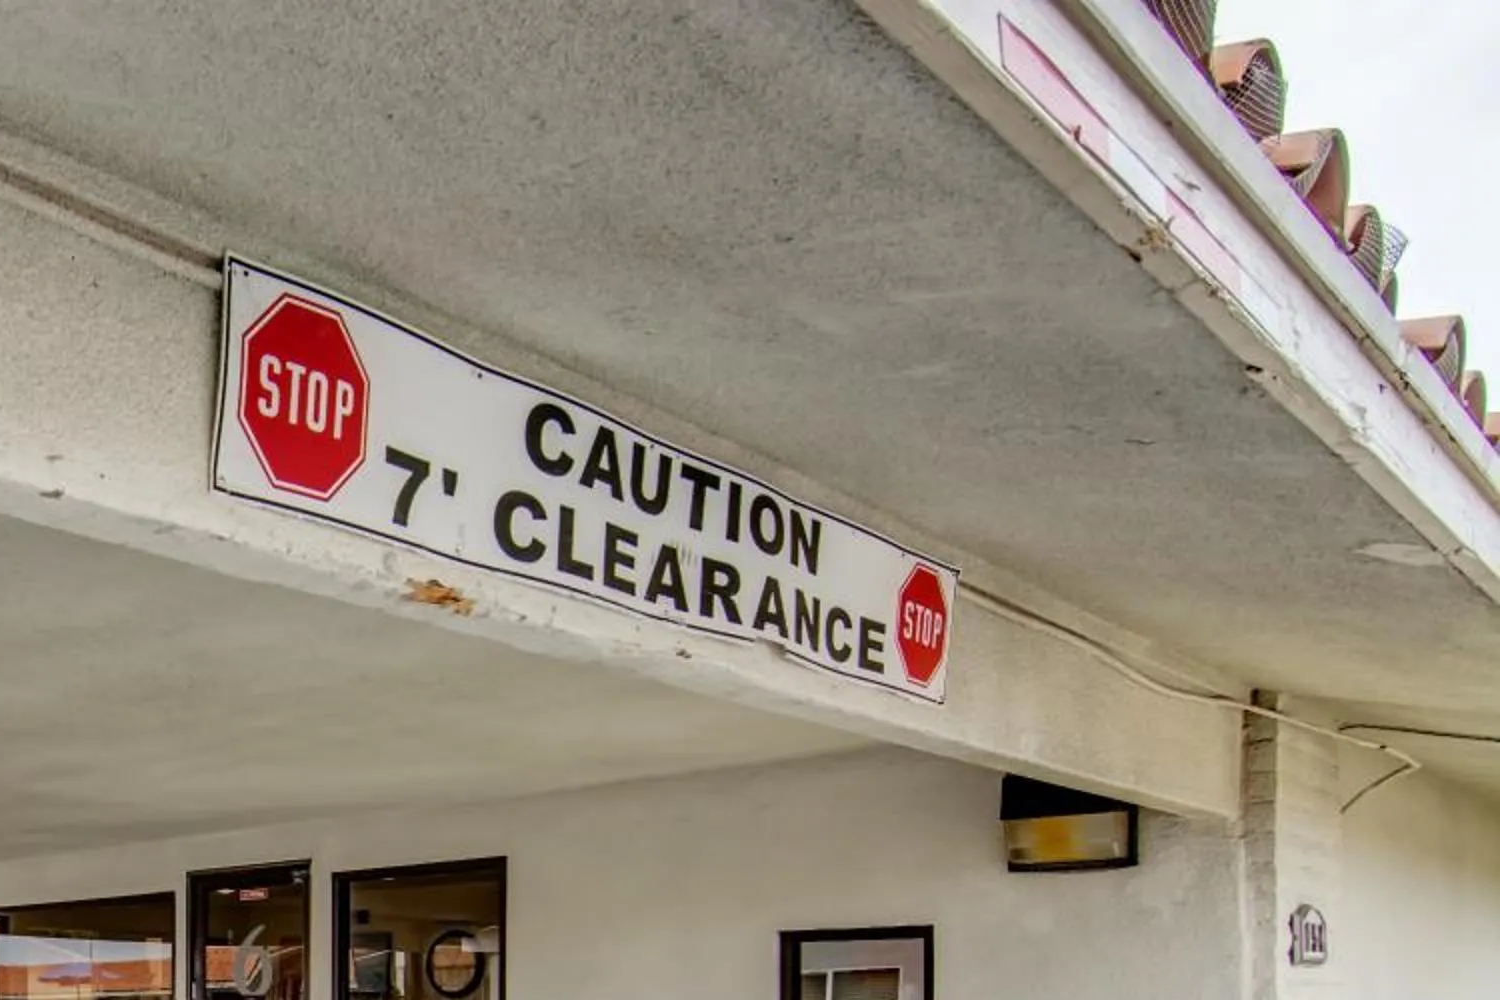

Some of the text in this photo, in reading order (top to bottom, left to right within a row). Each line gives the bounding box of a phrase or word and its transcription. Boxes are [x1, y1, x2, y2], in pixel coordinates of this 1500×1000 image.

[257, 353, 355, 441] STOP
[524, 402, 822, 576] CAUTION
[384, 445, 887, 674] 7' CLEARANCE
[903, 599, 943, 650] STOP
